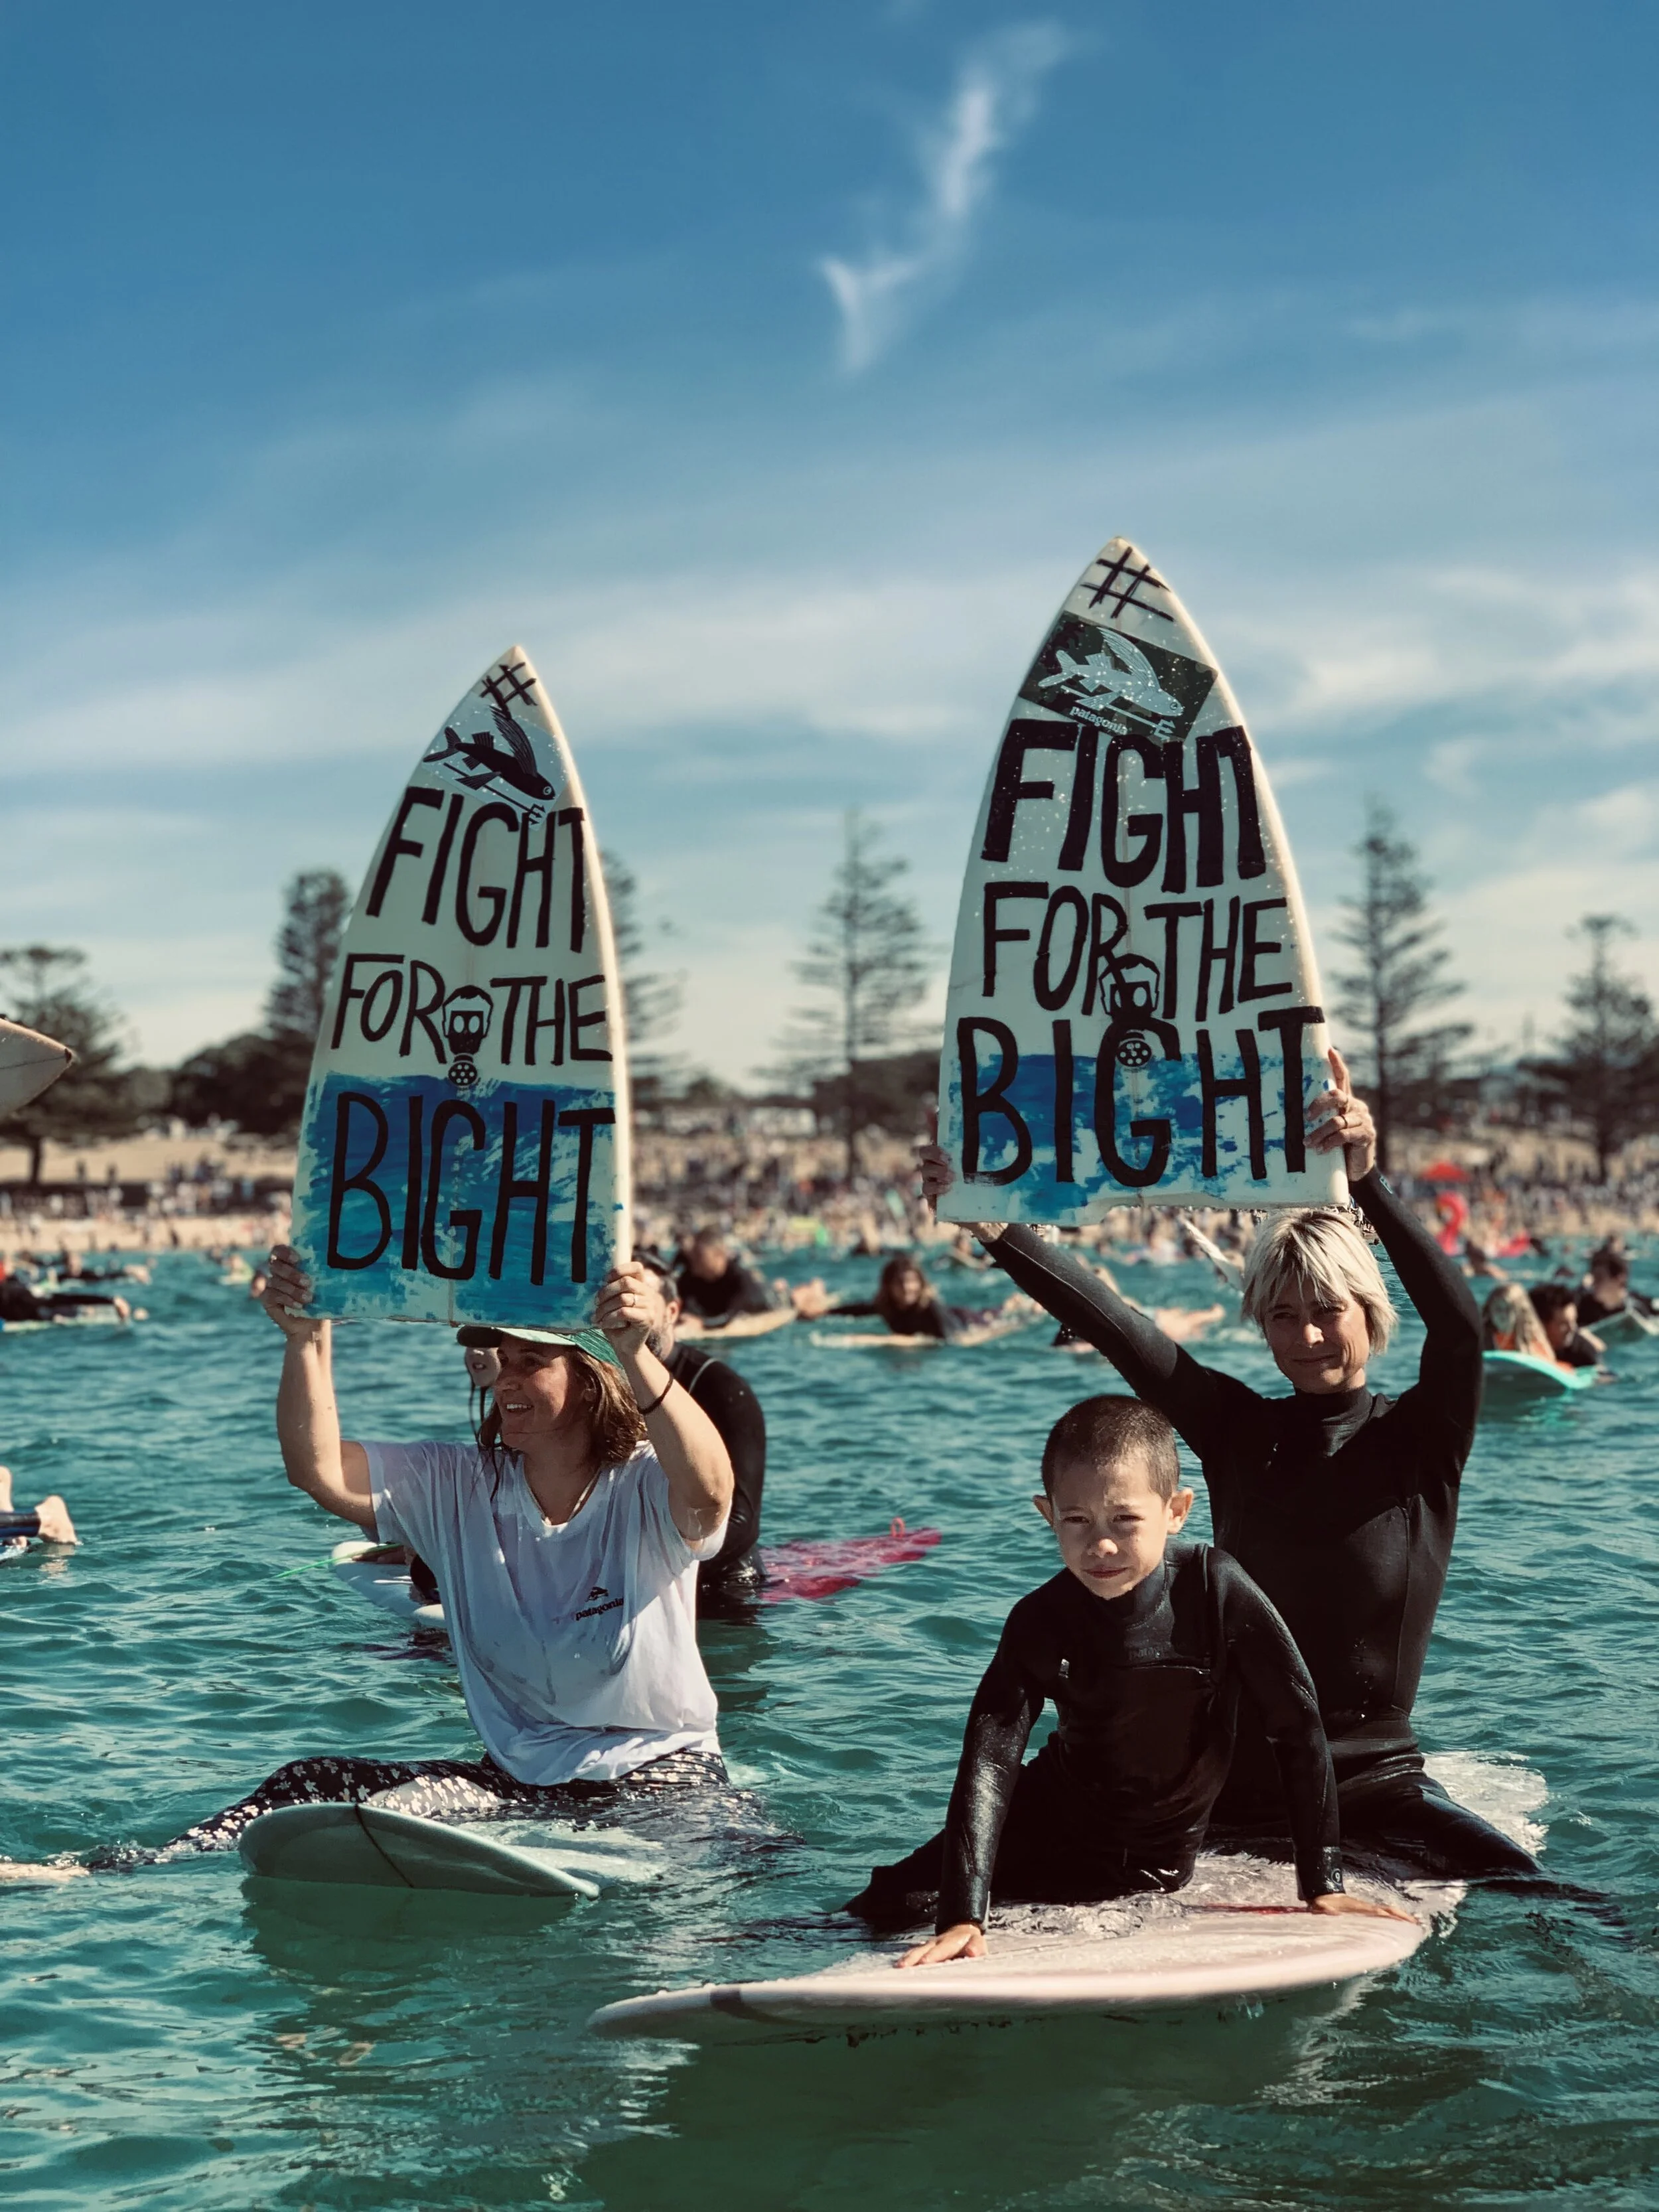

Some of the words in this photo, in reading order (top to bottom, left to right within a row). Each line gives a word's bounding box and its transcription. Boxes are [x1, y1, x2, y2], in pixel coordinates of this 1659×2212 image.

[1070, 706, 1128, 735] patagonia
[366, 787, 587, 954] FIGHT
[981, 718, 1267, 893] FIGHT
[330, 953, 447, 1065] FOR
[490, 974, 613, 1067] THE
[983, 881, 1129, 1015] FOR
[1145, 897, 1295, 1022] THE
[958, 1006, 1326, 1187] BIGHT
[327, 1092, 616, 1285] BIGHT
[576, 1598, 624, 1621] patagonia
